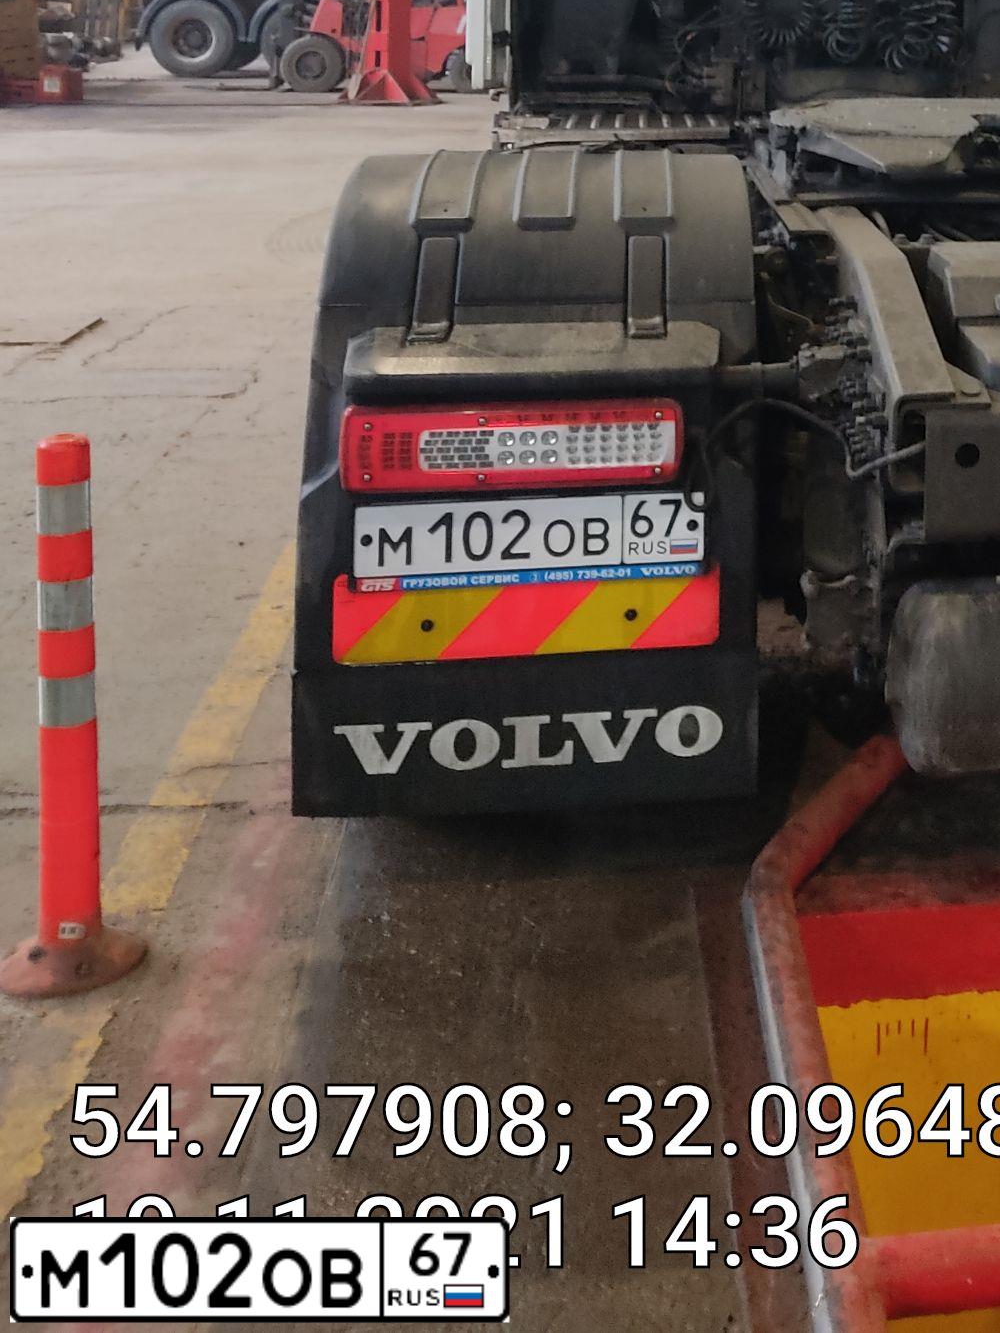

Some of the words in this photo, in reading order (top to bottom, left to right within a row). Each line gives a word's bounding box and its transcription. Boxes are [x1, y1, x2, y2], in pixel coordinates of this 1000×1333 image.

[629, 498, 682, 538] 67
[629, 539, 667, 556] RUS
[361, 578, 396, 592] GTS
[402, 575, 467, 589] ГРУЗОВОЙ
[470, 573, 520, 586] СЕРВИС
[544, 570, 574, 582] (495)
[639, 564, 697, 576] VOLVO
[333, 704, 724, 776] VOLVO
